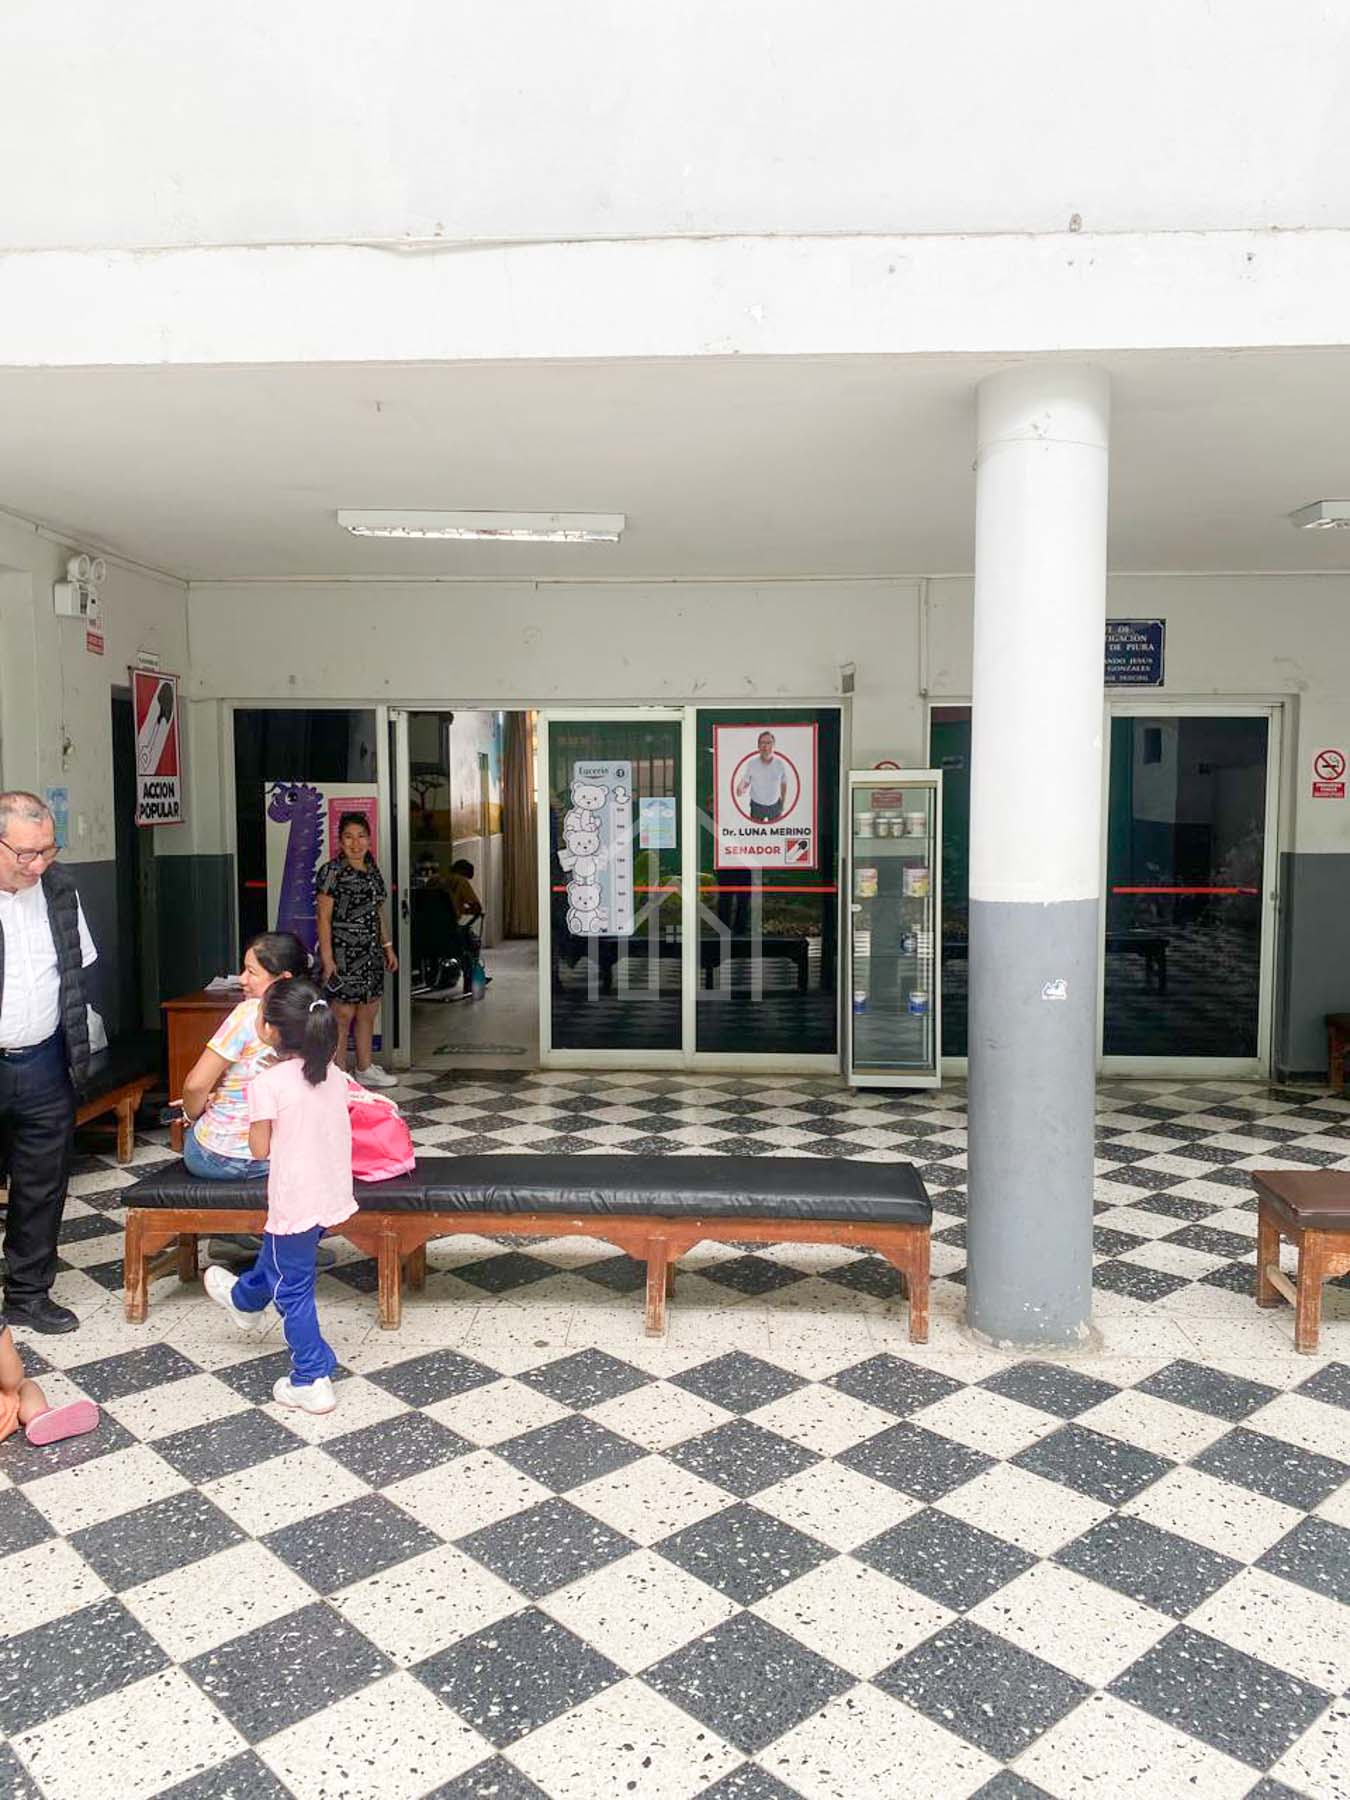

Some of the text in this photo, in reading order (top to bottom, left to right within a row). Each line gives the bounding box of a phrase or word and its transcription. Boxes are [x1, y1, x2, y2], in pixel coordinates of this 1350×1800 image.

[1109, 643, 1155, 651] DE PIURA
[143, 782, 175, 799] ACCION
[139, 802, 180, 820] POPULAR
[722, 827, 812, 837] Dr. LUNA MERINO
[725, 846, 782, 855] SENADOR
